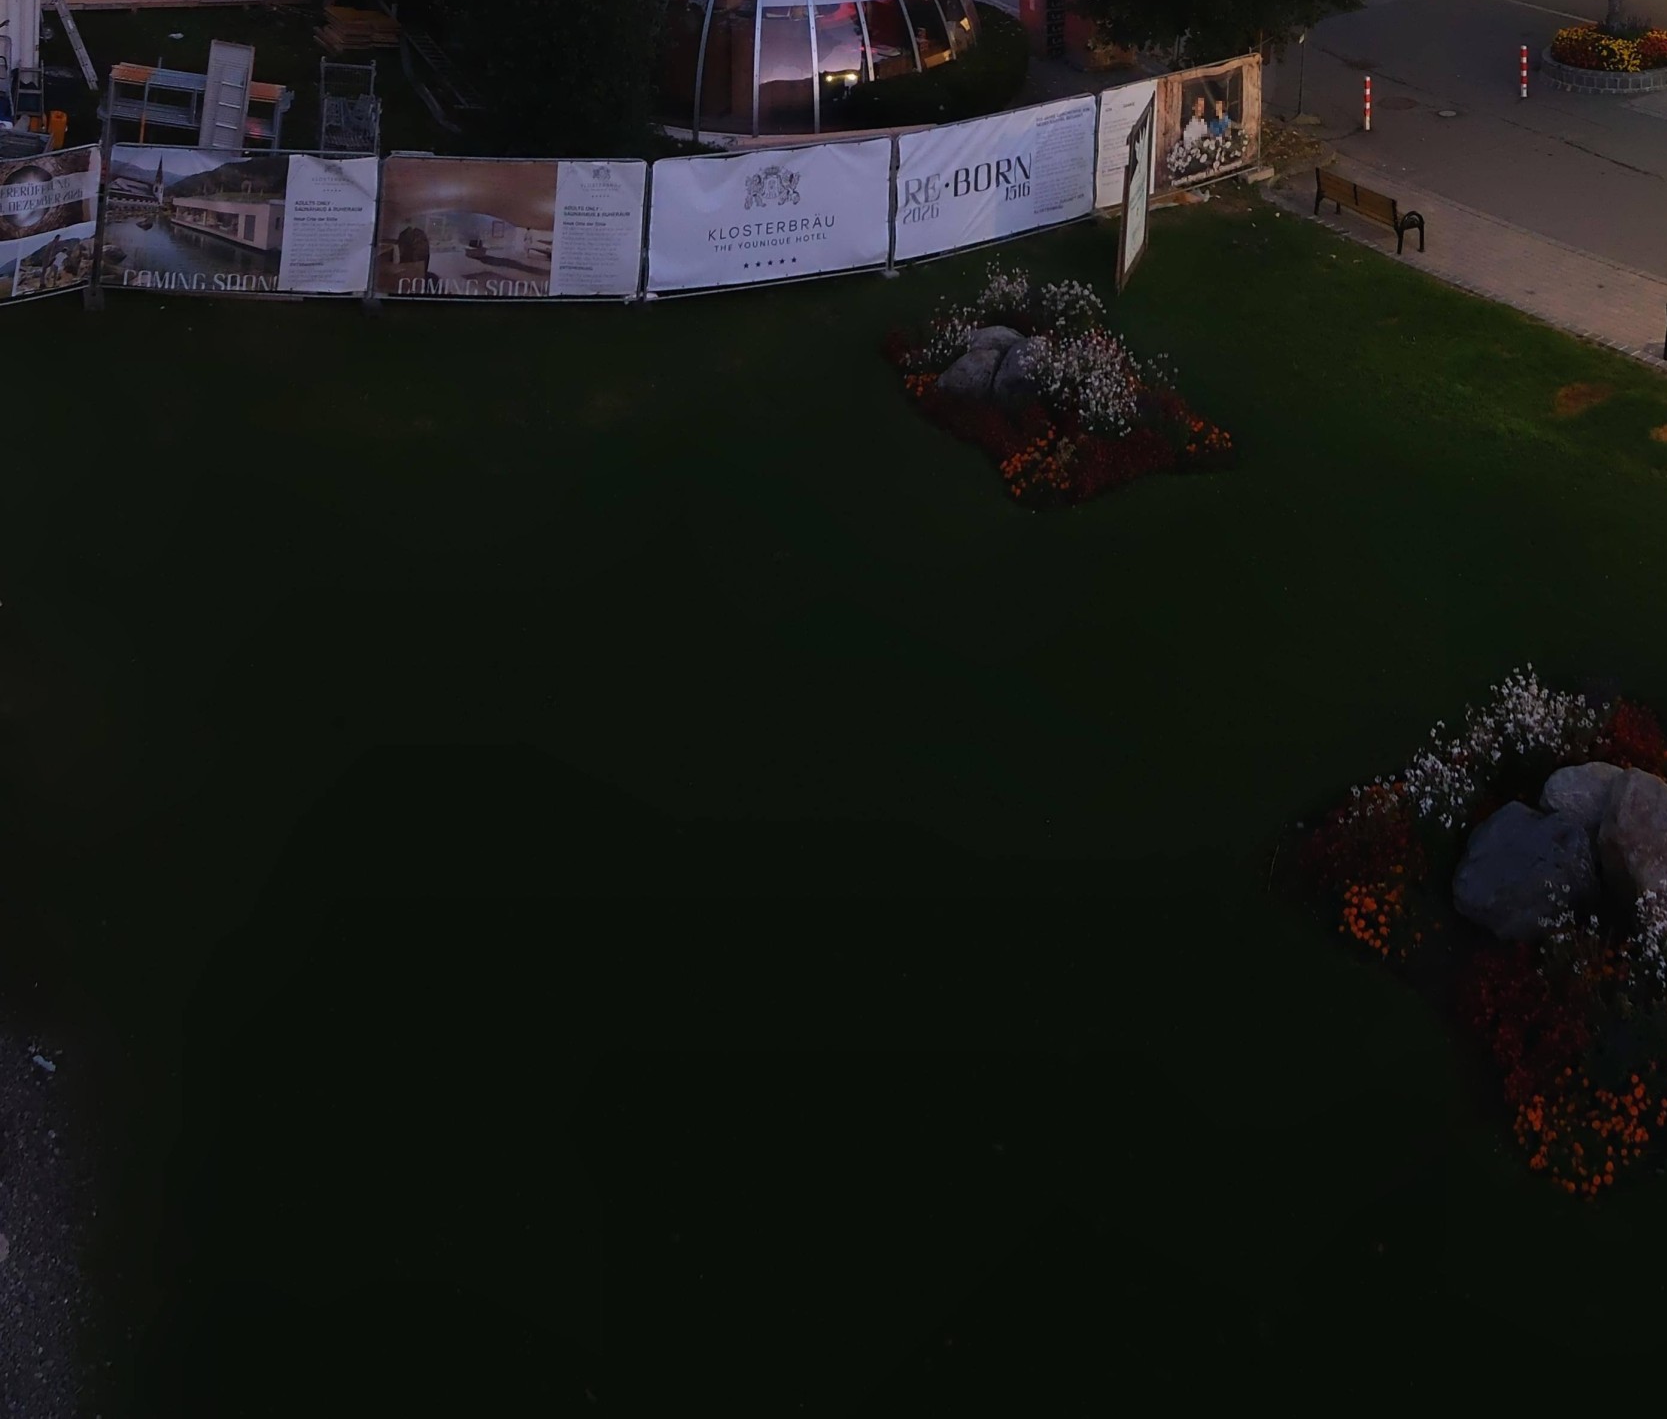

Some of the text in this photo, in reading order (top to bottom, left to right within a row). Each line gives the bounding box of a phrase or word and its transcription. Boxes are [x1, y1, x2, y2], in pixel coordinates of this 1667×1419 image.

[1005, 181, 1031, 201] 1516
[8, 193, 61, 211] DEZEMBER
[903, 203, 939, 224] 2026
[708, 213, 835, 242] KLOSTERBRÄU
[714, 233, 827, 252] THE YOUNIQUE HOTEL
